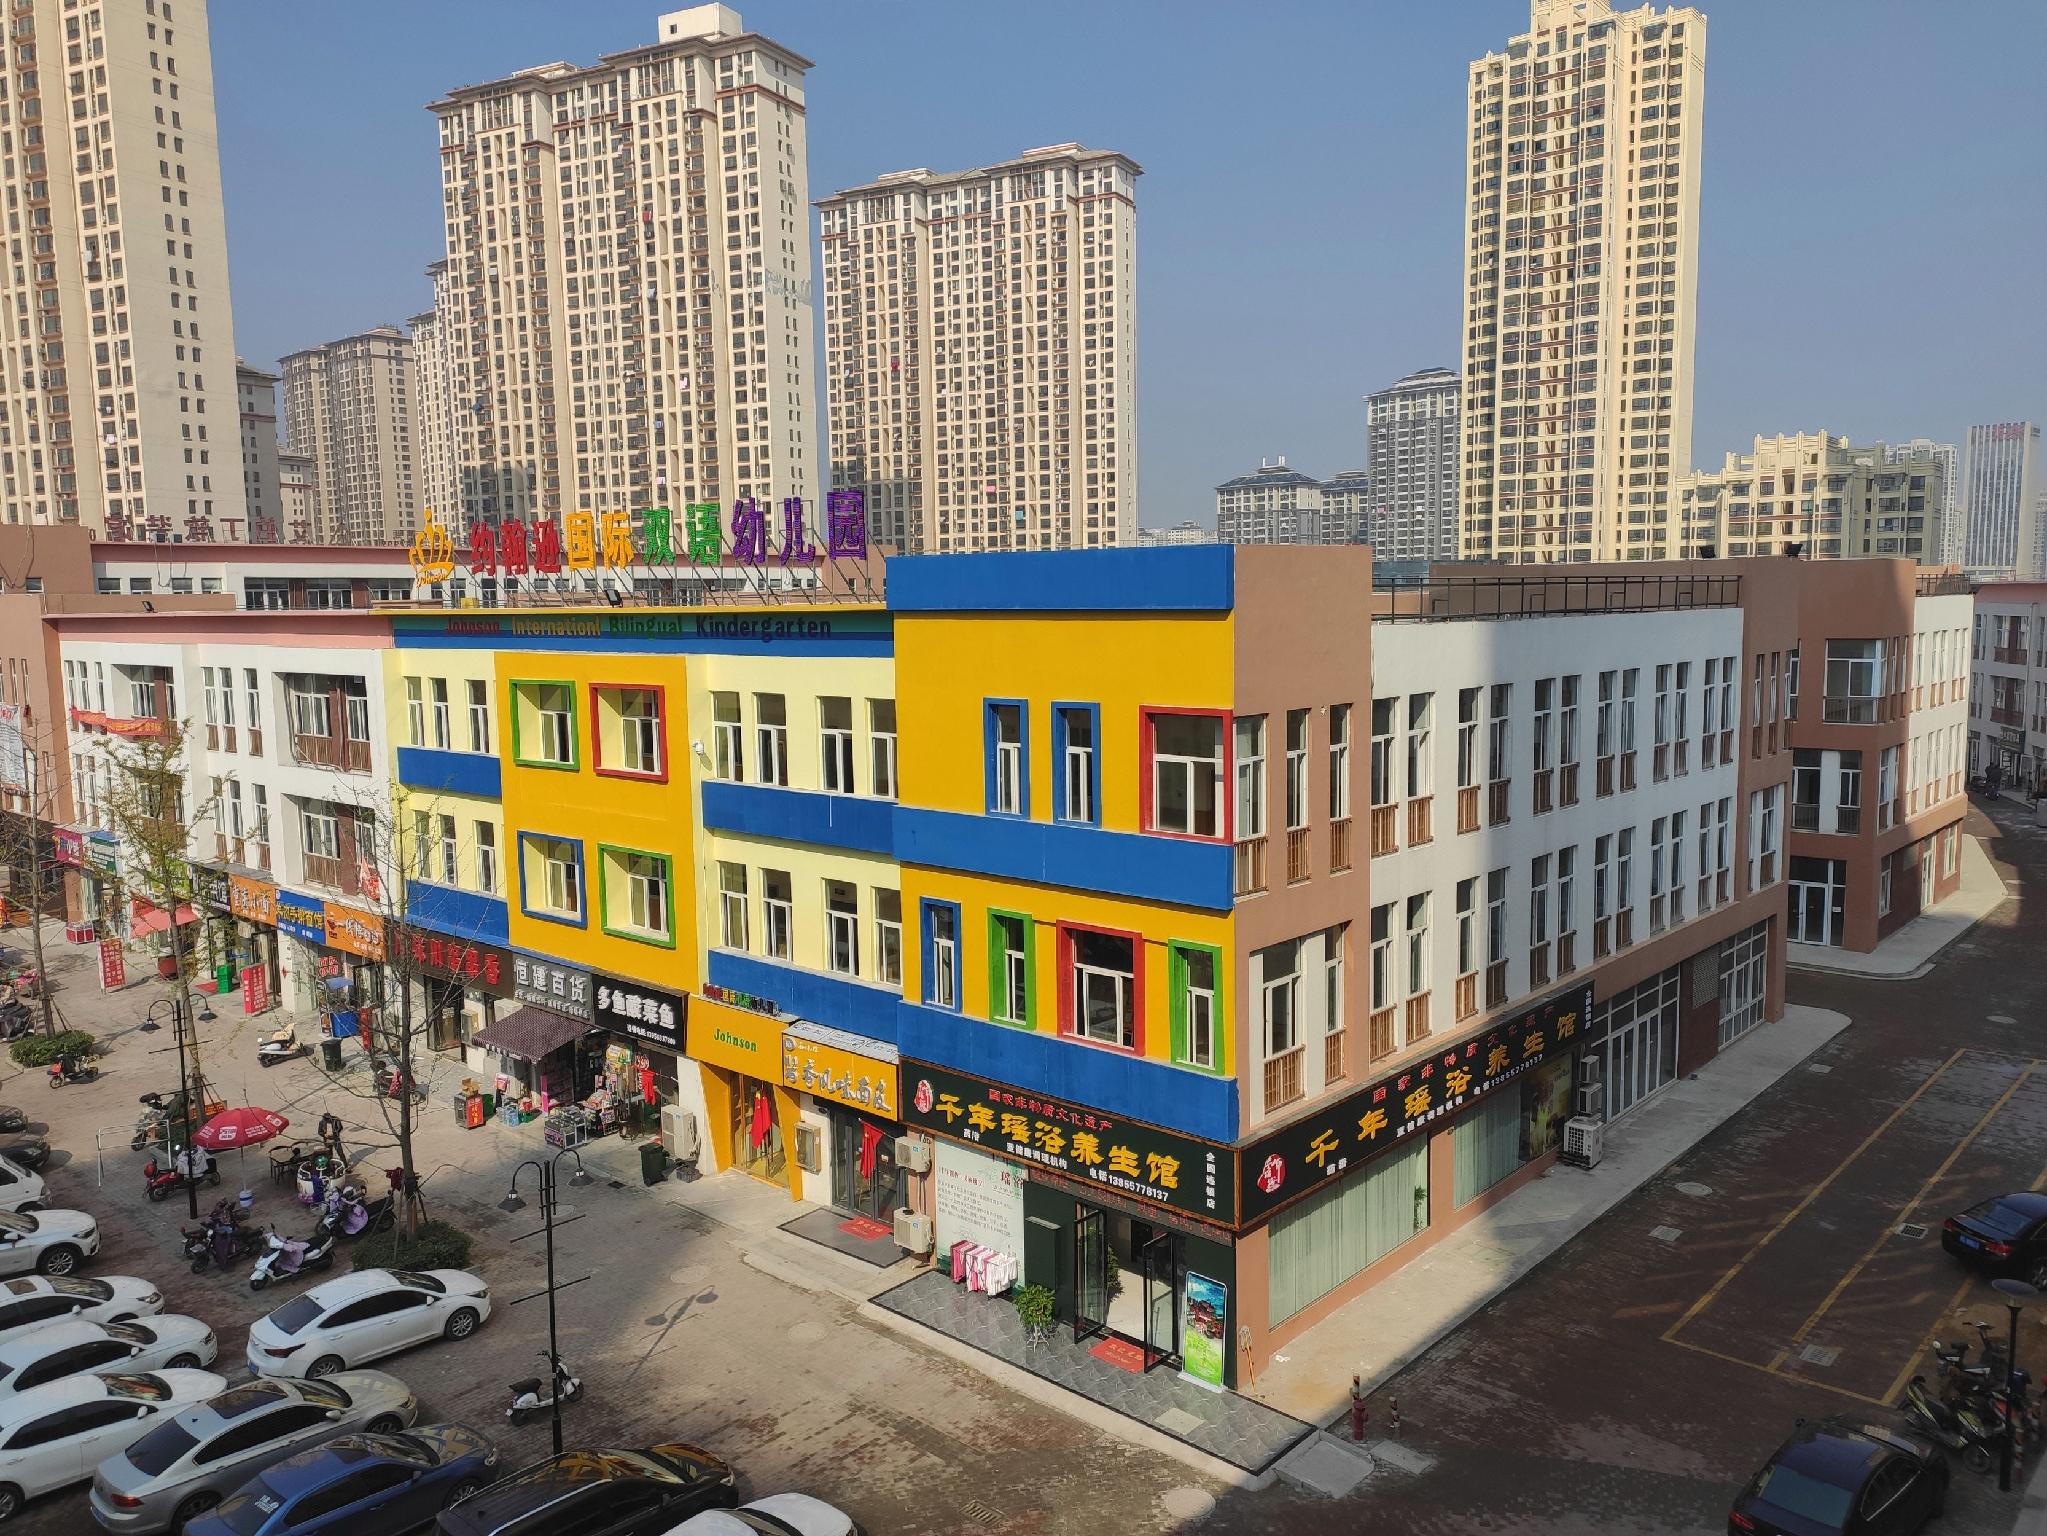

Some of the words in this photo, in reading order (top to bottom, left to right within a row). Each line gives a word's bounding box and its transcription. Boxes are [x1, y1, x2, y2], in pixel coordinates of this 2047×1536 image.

[448, 616, 500, 634] Johnson
[609, 614, 683, 640] Bilingual
[696, 615, 831, 643] Kindergarten
[714, 1028, 757, 1052] Johnson
[988, 1088, 1113, 1131] 国家非物质文化遗产
[1305, 1012, 1577, 1167] 千年瑶浴养生馆
[936, 1093, 1180, 1189] 千年瑶浴养生馆
